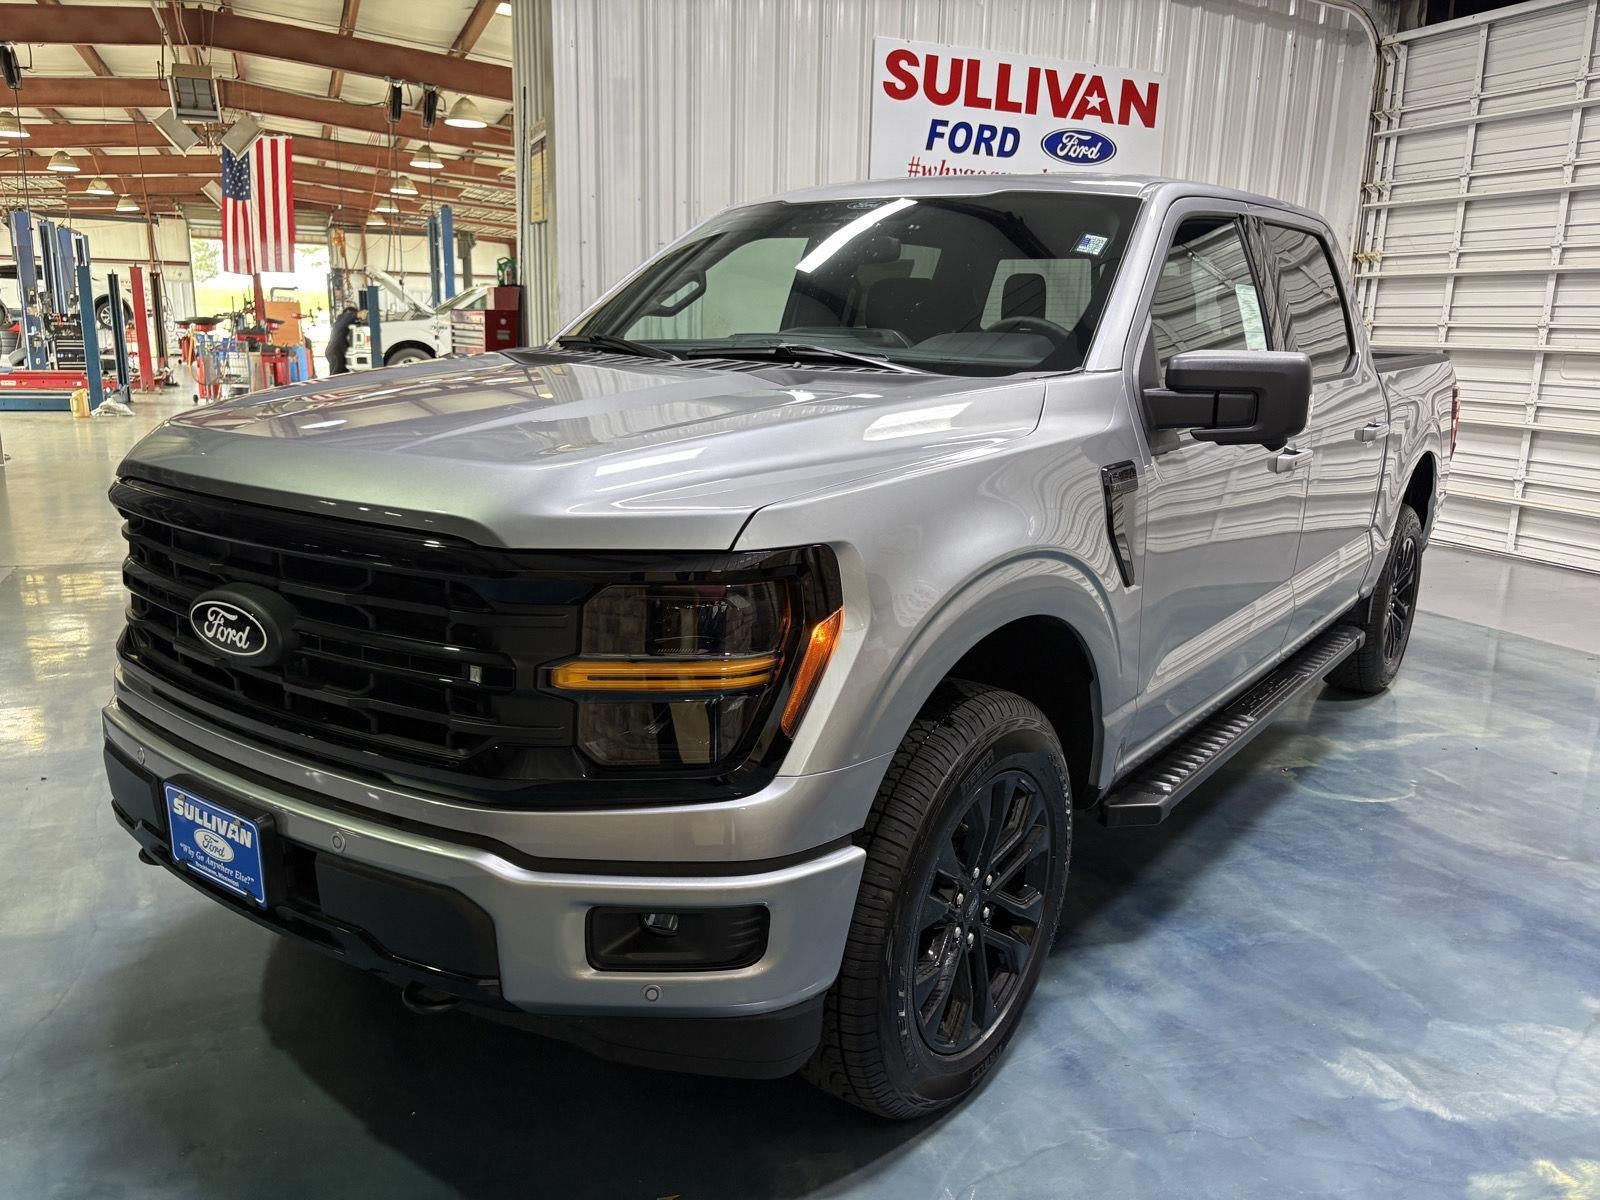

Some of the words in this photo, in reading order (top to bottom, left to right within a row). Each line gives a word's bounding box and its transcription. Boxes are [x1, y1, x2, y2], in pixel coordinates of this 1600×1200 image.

[883, 49, 1159, 128] SULLIVAN
[925, 119, 1020, 158] FORD
[1057, 132, 1102, 159] Ford
[204, 606, 250, 649] Ford
[173, 796, 252, 849] SULLIVAN
[202, 834, 226, 858] Ford
